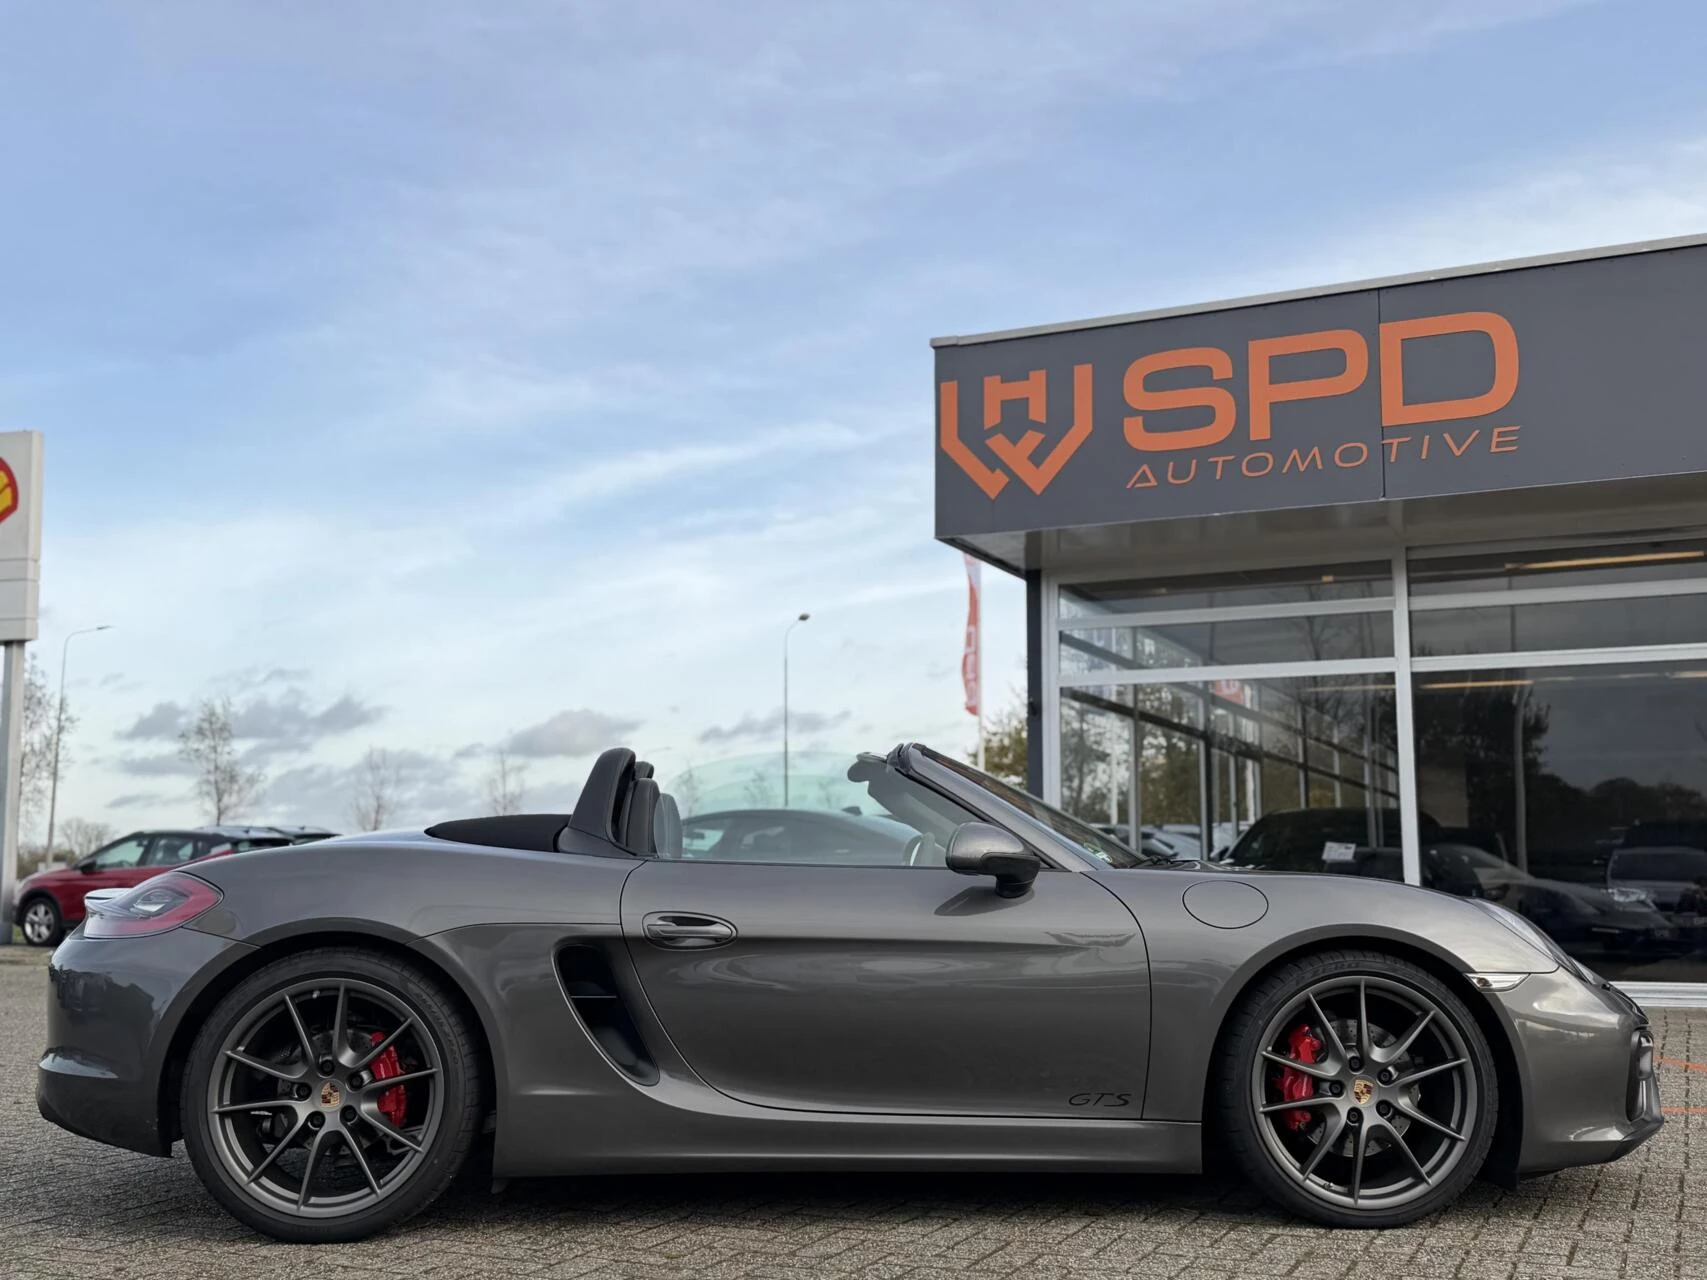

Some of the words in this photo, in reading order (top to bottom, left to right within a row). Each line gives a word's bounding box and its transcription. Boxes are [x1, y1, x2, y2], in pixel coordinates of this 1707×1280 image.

[1122, 311, 1519, 452] SPD
[1126, 425, 1520, 489] AUTOMOTIVE
[1068, 1092, 1132, 1107] GTS
